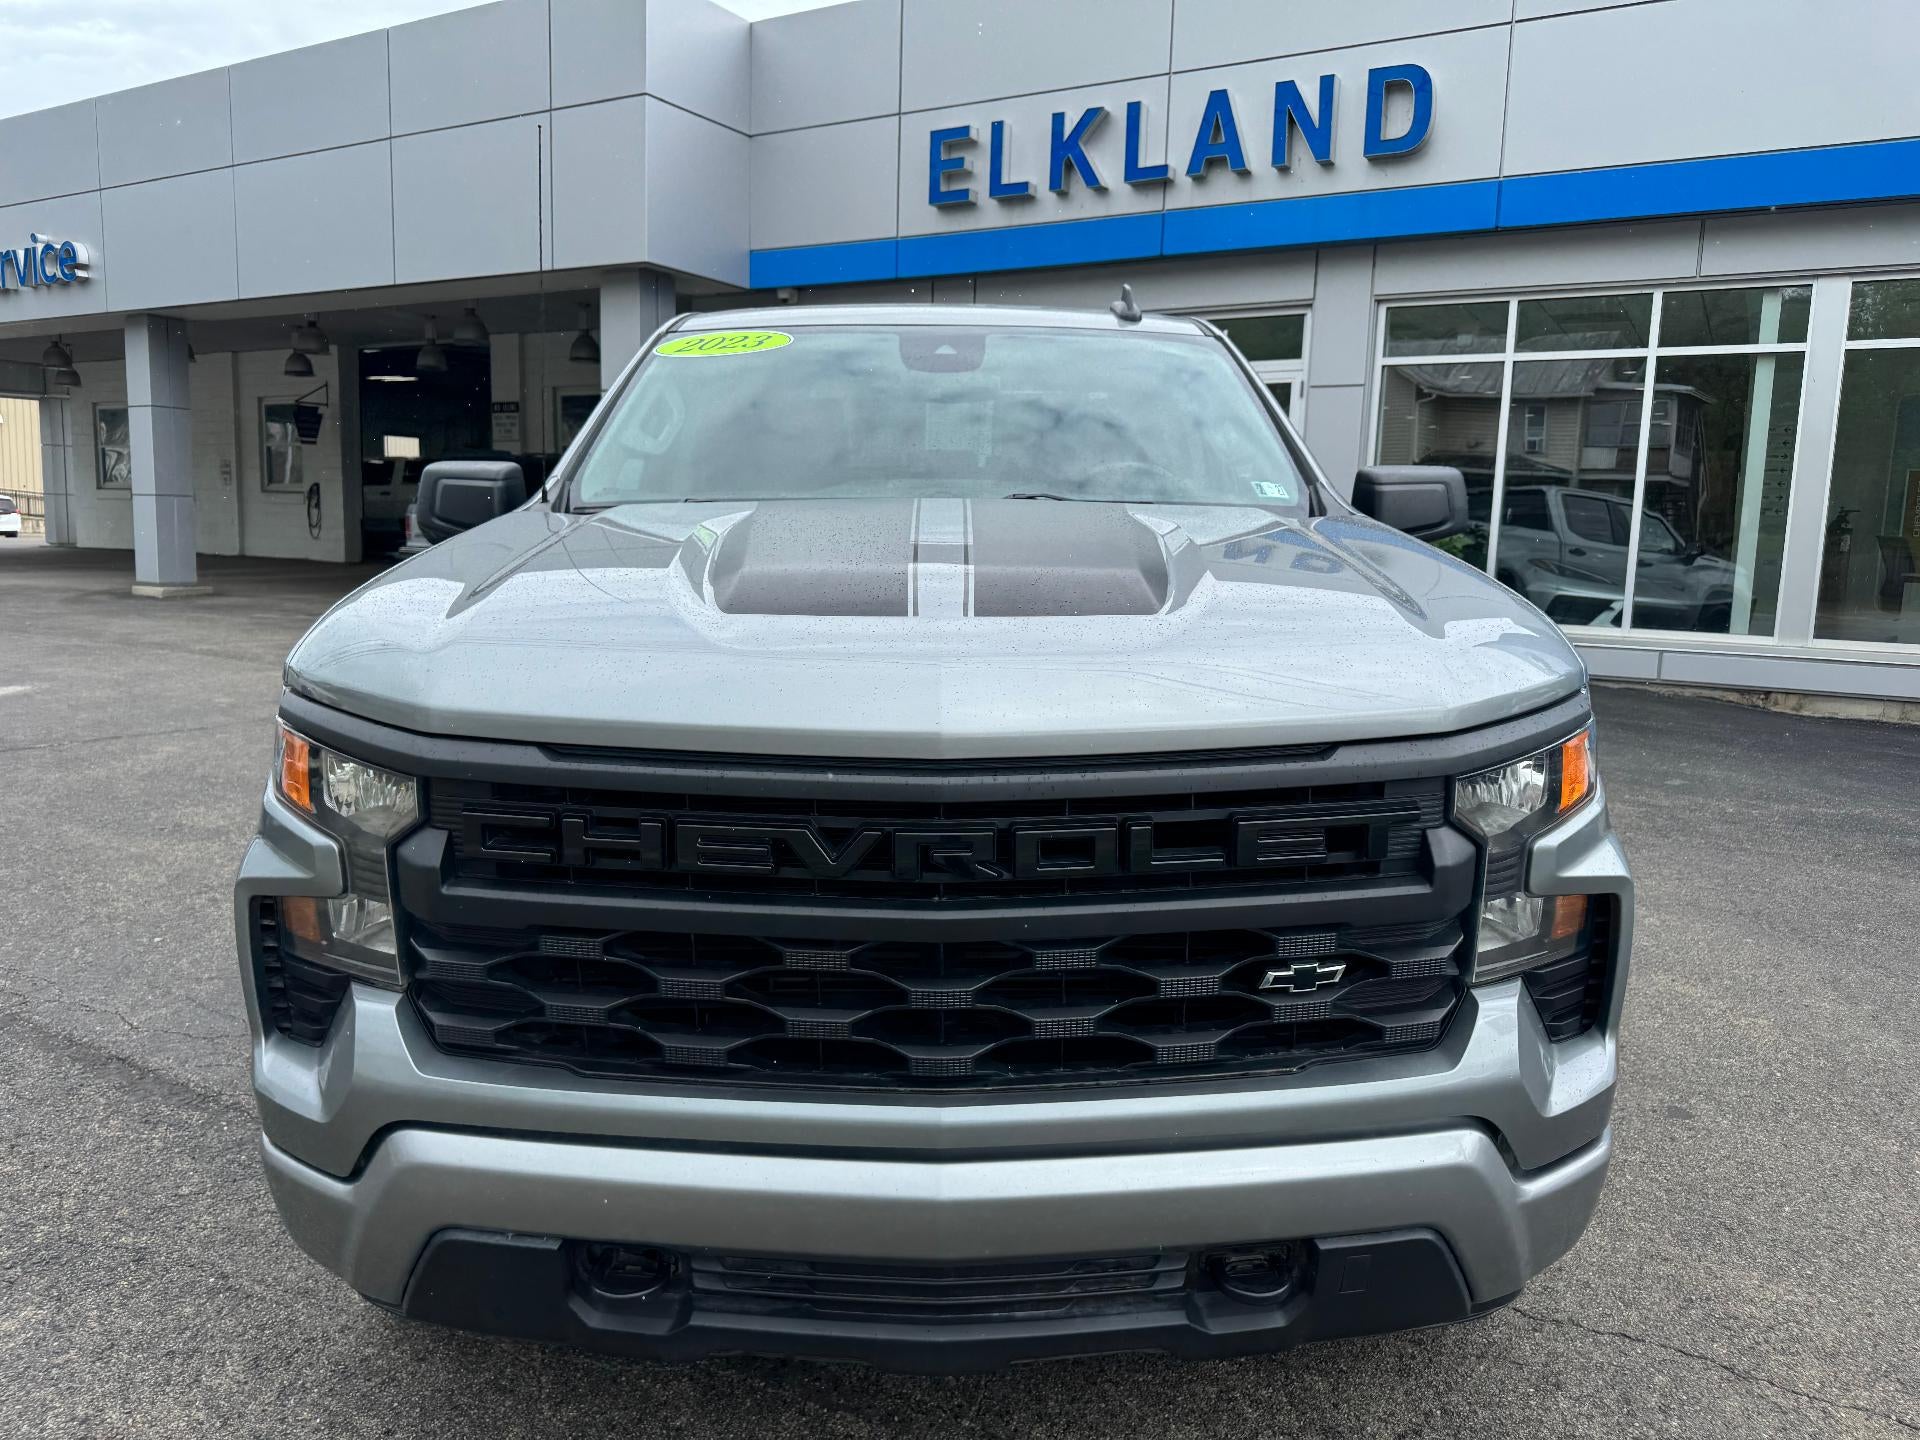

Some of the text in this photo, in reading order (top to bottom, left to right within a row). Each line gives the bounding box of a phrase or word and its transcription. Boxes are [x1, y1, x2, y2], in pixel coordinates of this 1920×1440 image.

[928, 63, 1434, 207] ELKLAND
[674, 335, 772, 353] 2023
[462, 799, 1422, 880] CHEVROLET
